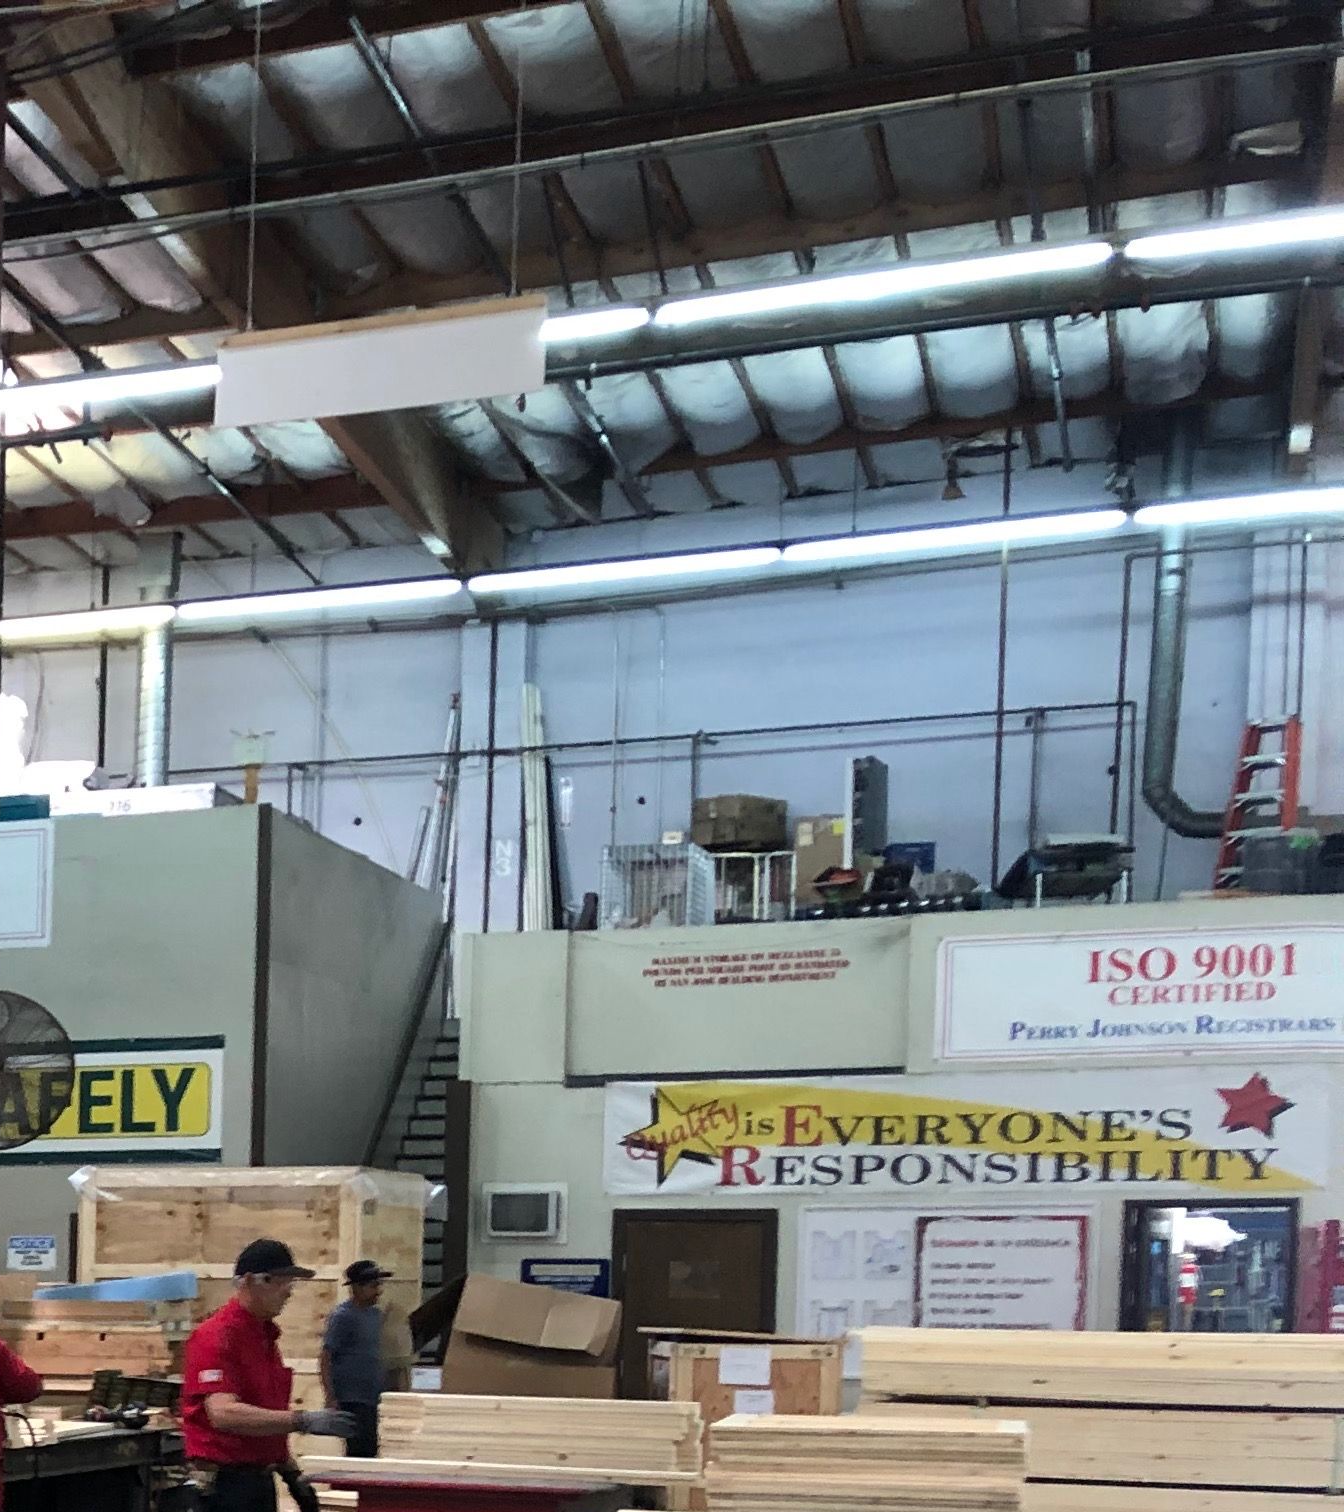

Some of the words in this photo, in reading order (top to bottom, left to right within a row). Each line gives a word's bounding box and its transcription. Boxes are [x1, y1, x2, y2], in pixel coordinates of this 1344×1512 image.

[1087, 946, 1177, 984] ISO
[1192, 942, 1299, 979] 9001
[1107, 981, 1277, 1006] CERTIFIED
[1010, 1021, 1080, 1040] PERRY
[1086, 1018, 1187, 1038] JOHNSON
[1195, 1014, 1336, 1035] REGISTRARS
[744, 1111, 776, 1137] is
[778, 1105, 1193, 1147] EVERYONE'S
[716, 1144, 1279, 1187] RESPONSIBILITY
